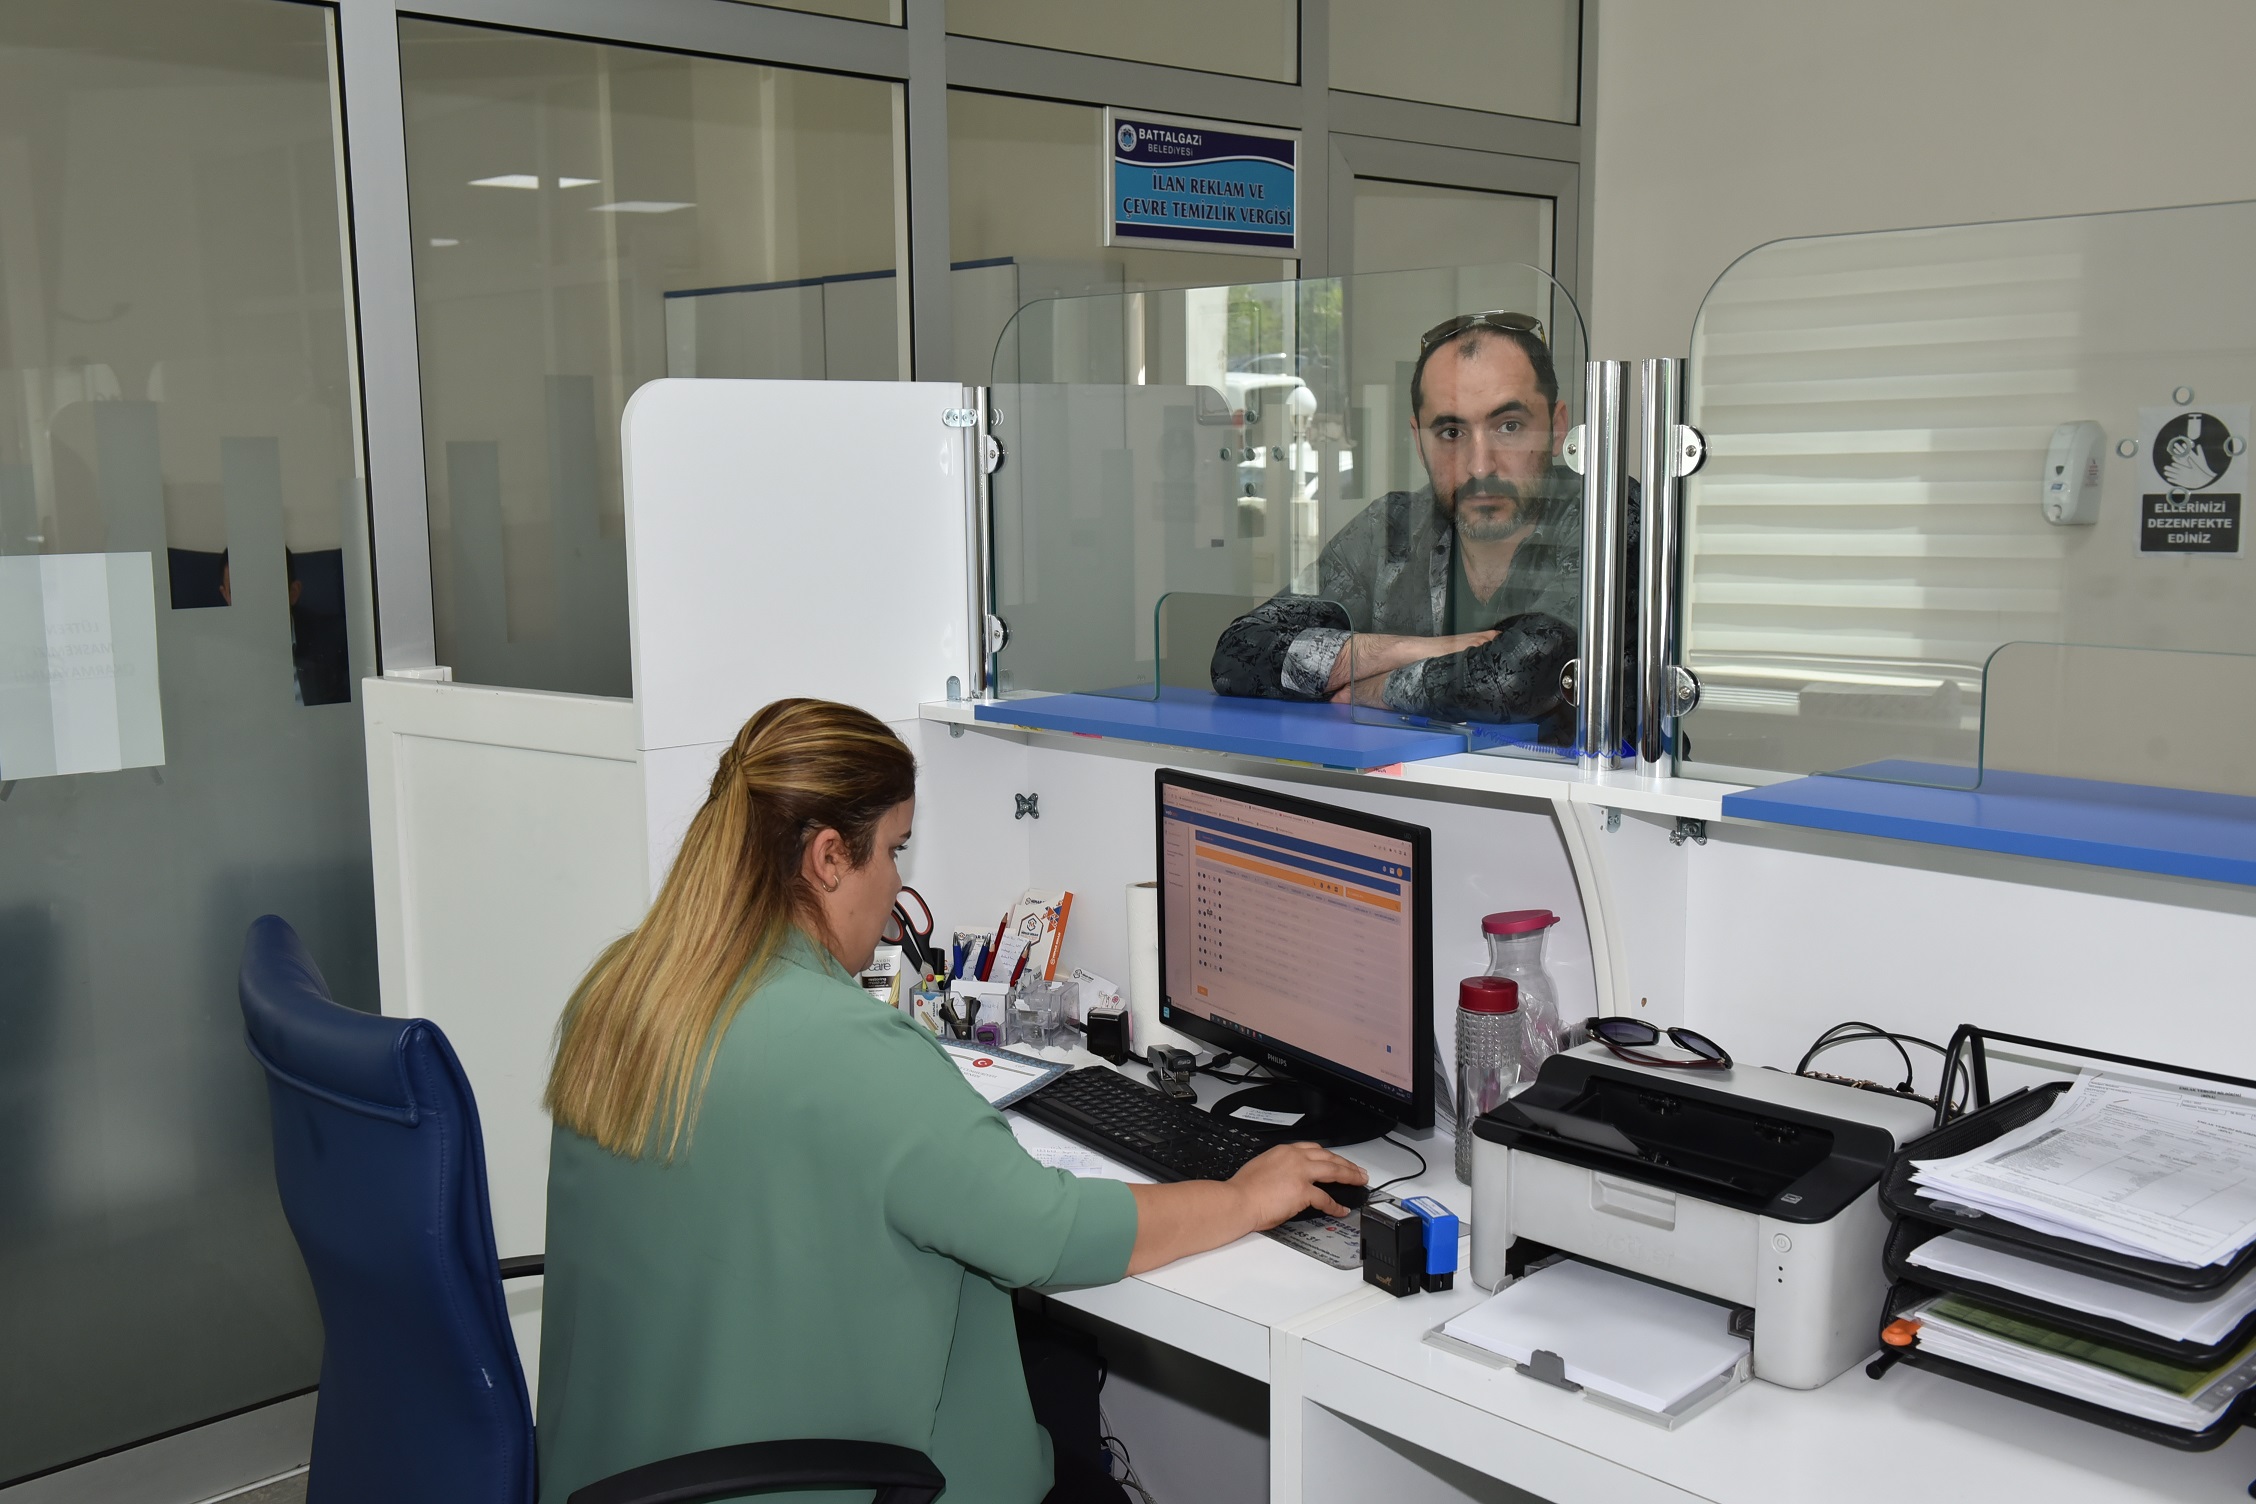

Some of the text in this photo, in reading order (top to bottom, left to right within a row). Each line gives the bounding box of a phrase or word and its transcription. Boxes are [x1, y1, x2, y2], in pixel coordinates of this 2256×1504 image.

[1152, 169, 1265, 199] İLAN REKLAM VE
[1123, 197, 1292, 226] ÇEVRE TEMİZLİK VERGİSİ
[2154, 501, 2226, 514] ELLERİNİZİ
[2147, 518, 2233, 529] DEZENFEKTE
[2167, 531, 2211, 544] EDİNİZ
[869, 962, 892, 971] care
[1267, 1053, 1288, 1067] PHILIPS
